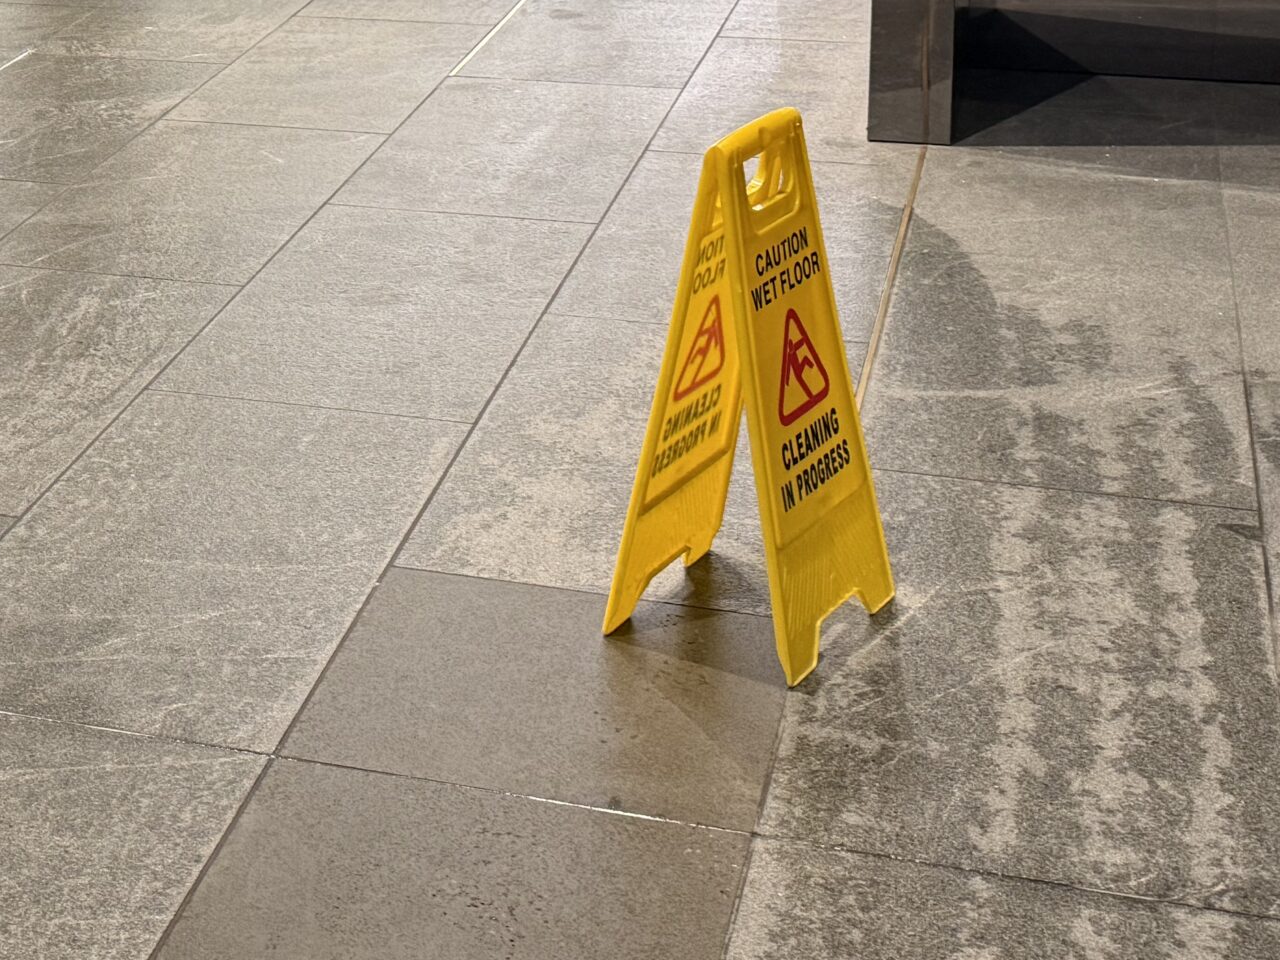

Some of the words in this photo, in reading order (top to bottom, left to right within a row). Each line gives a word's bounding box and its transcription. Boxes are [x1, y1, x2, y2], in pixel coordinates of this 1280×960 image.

[751, 276, 778, 312] WET
[779, 251, 821, 295] FLOOR
[755, 226, 808, 277] CAUTION
[781, 407, 840, 471] CLEANING
[781, 484, 796, 513] IN
[796, 438, 851, 494] PROGRESS
